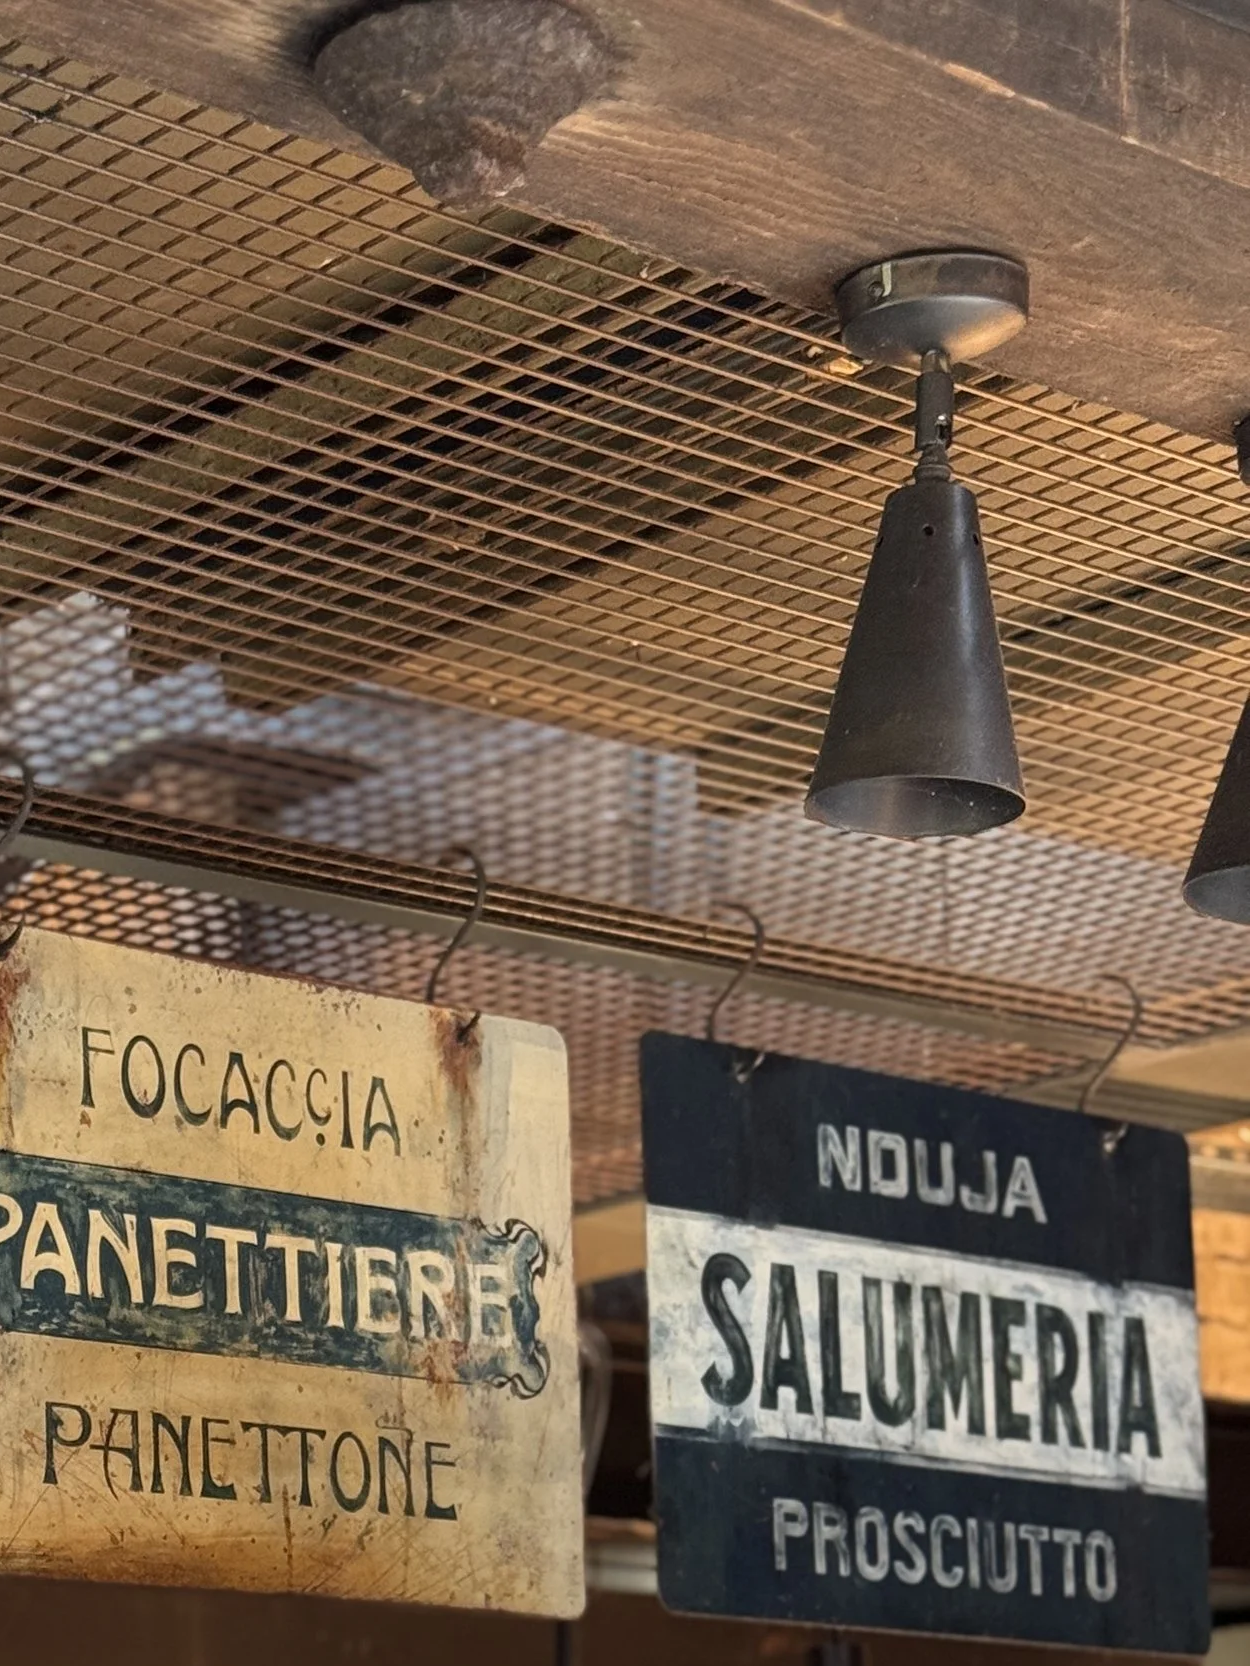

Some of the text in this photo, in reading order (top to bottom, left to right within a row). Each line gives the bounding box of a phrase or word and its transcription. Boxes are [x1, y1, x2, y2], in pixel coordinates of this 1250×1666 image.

[81, 1026, 401, 1156] FOCACCIA
[817, 1123, 1048, 1223] NDUJA
[700, 1252, 1162, 1458] SALUMERIA
[43, 1401, 458, 1520] PANETTONE
[772, 1497, 1117, 1602] PROSCIUTTO
